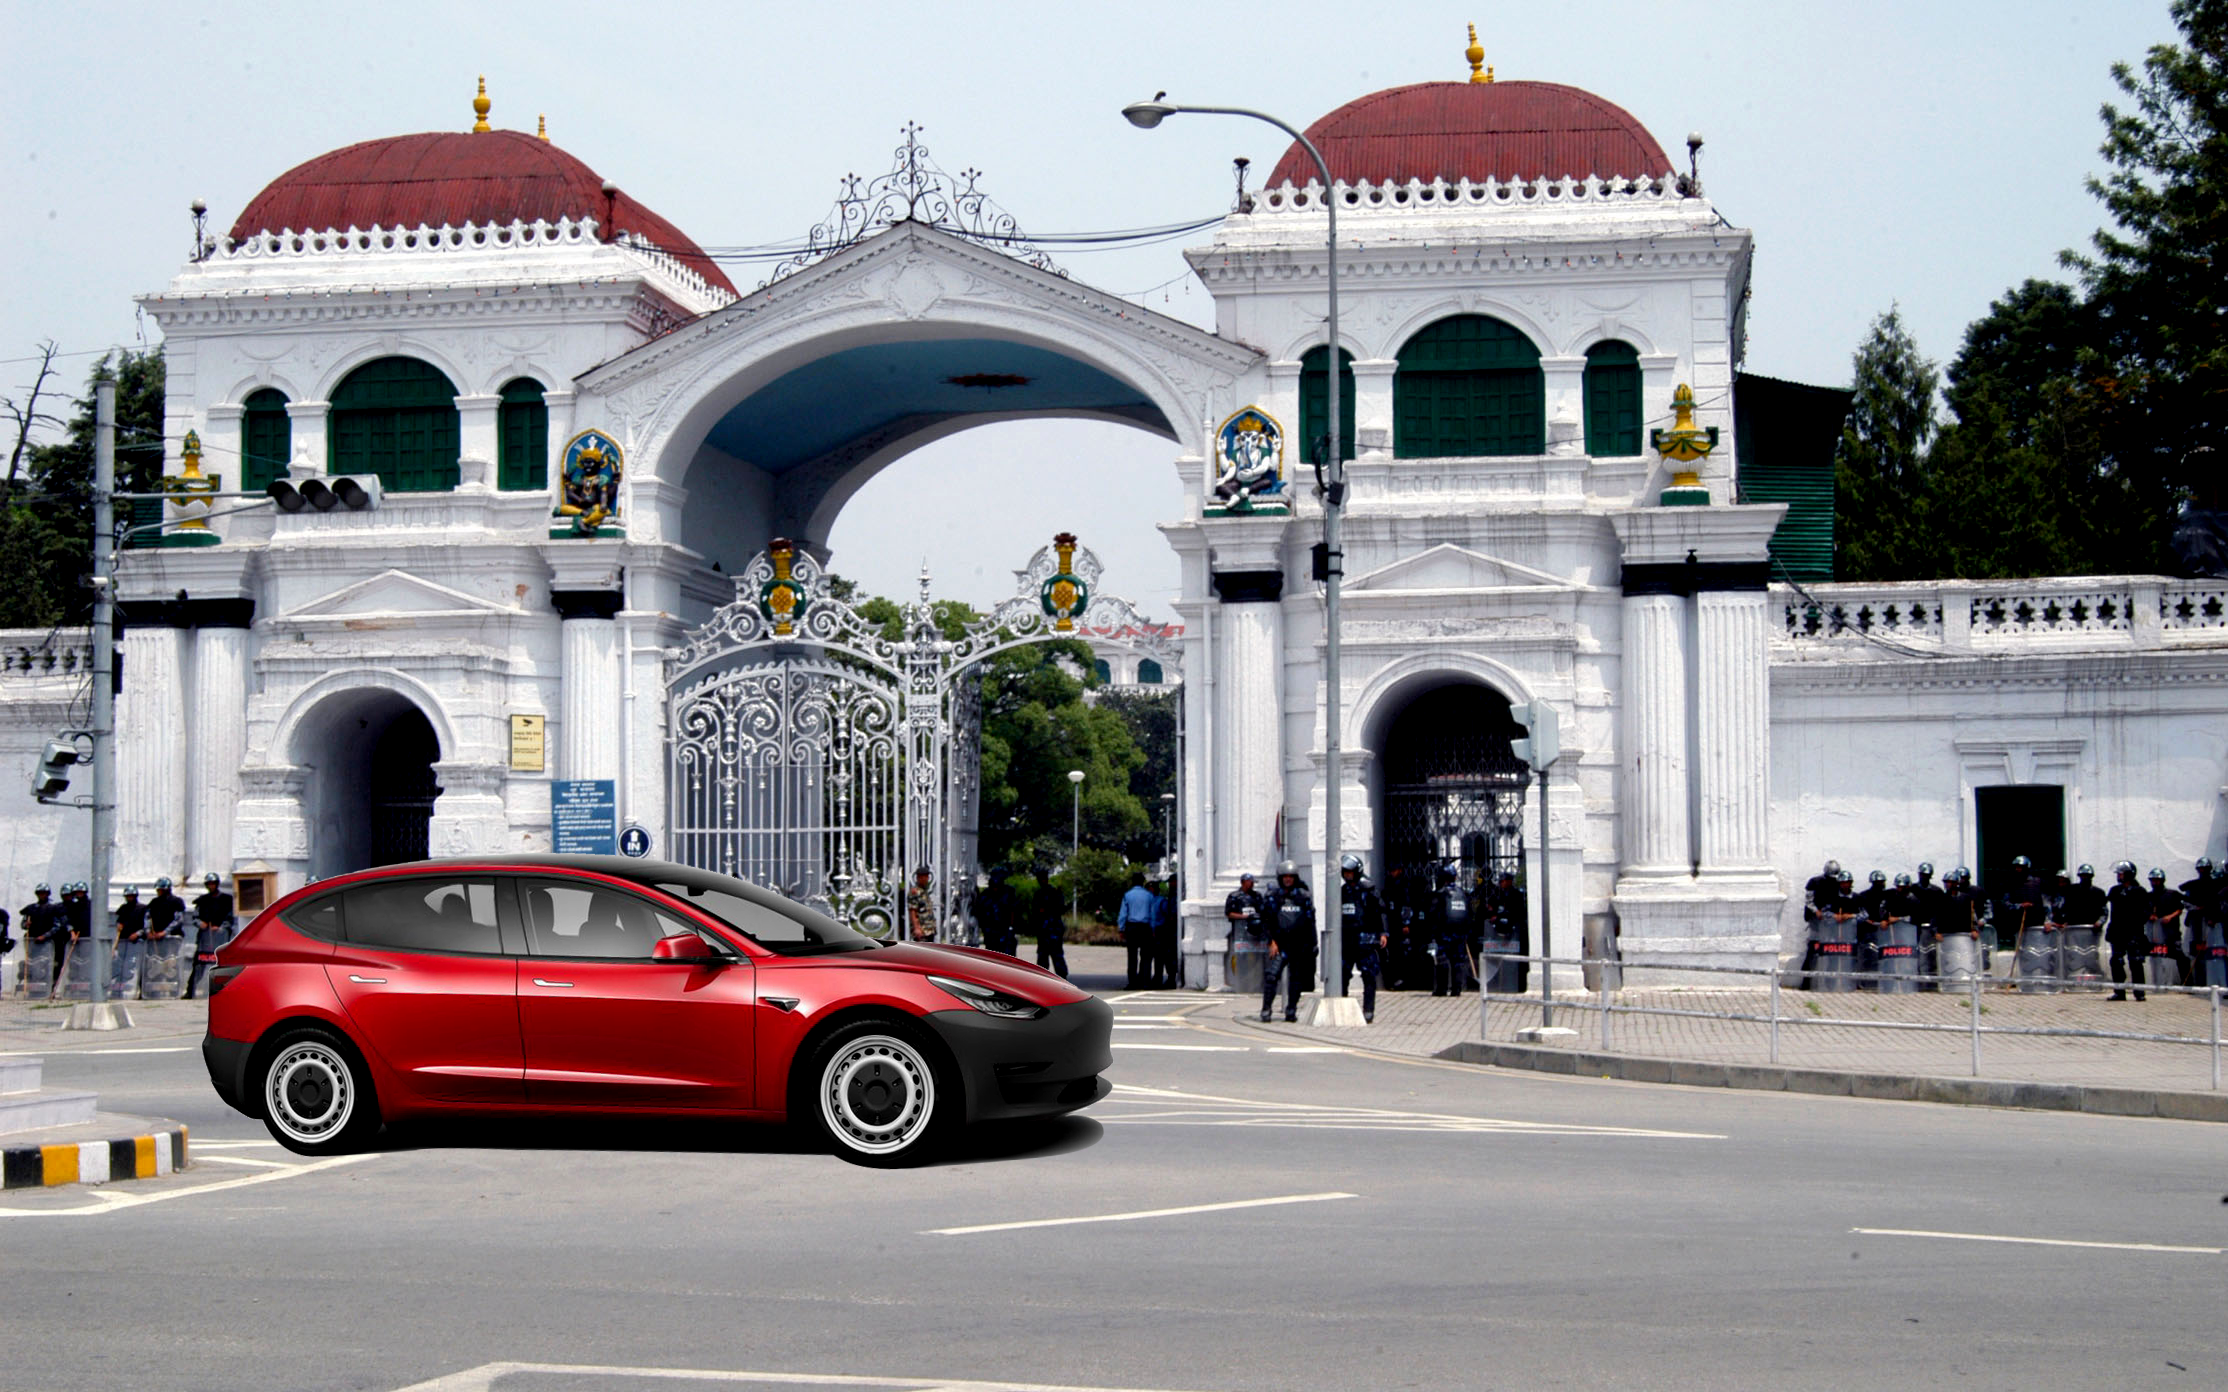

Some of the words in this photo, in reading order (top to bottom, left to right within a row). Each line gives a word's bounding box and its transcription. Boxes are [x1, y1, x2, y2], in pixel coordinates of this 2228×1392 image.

[628, 842, 641, 851] IN
[1823, 944, 1852, 953] POLICE
[1883, 946, 1913, 956] POLICE
